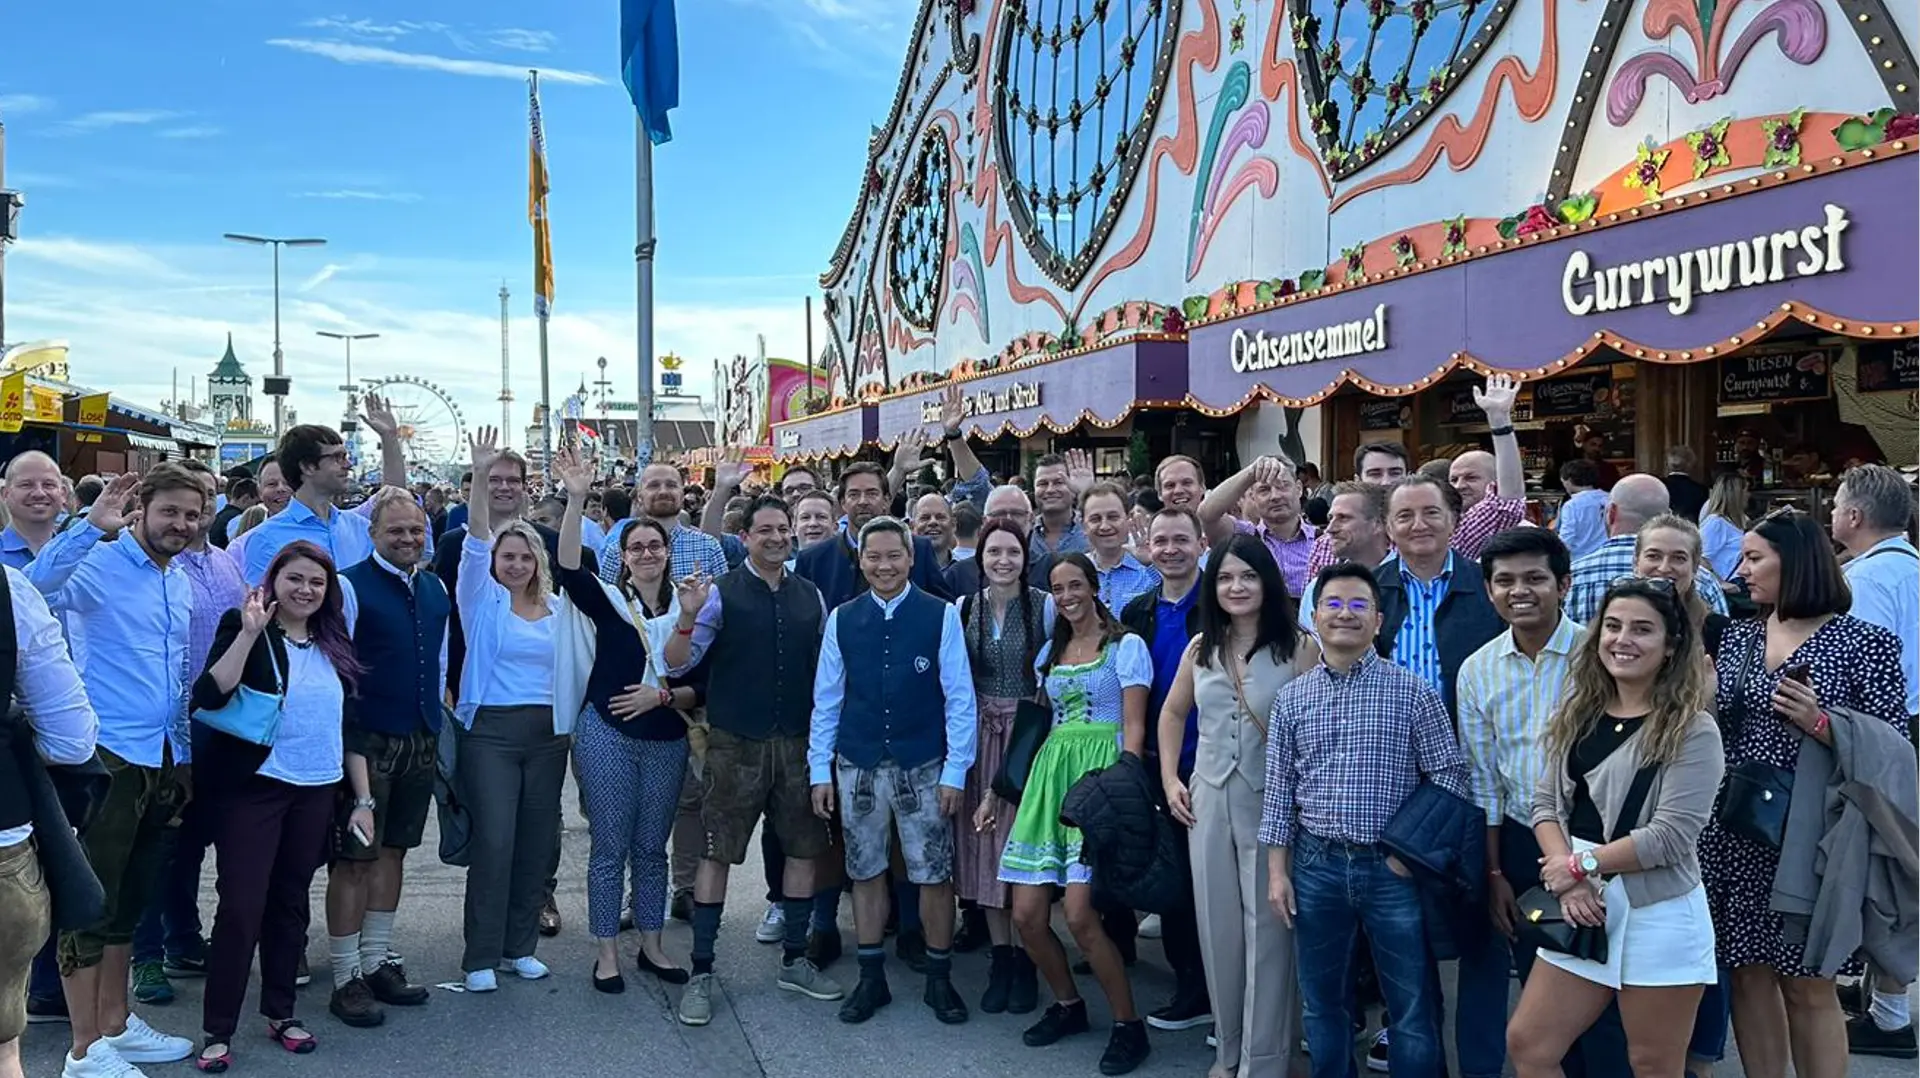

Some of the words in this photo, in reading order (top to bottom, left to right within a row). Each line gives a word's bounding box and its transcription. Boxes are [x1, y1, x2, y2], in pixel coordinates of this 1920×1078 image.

[1562, 203, 1850, 315] Currywurst
[1230, 303, 1387, 373] Ochsensemmel
[1724, 372, 1791, 398] Currywurst
[1746, 355, 1793, 372] RIESEN
